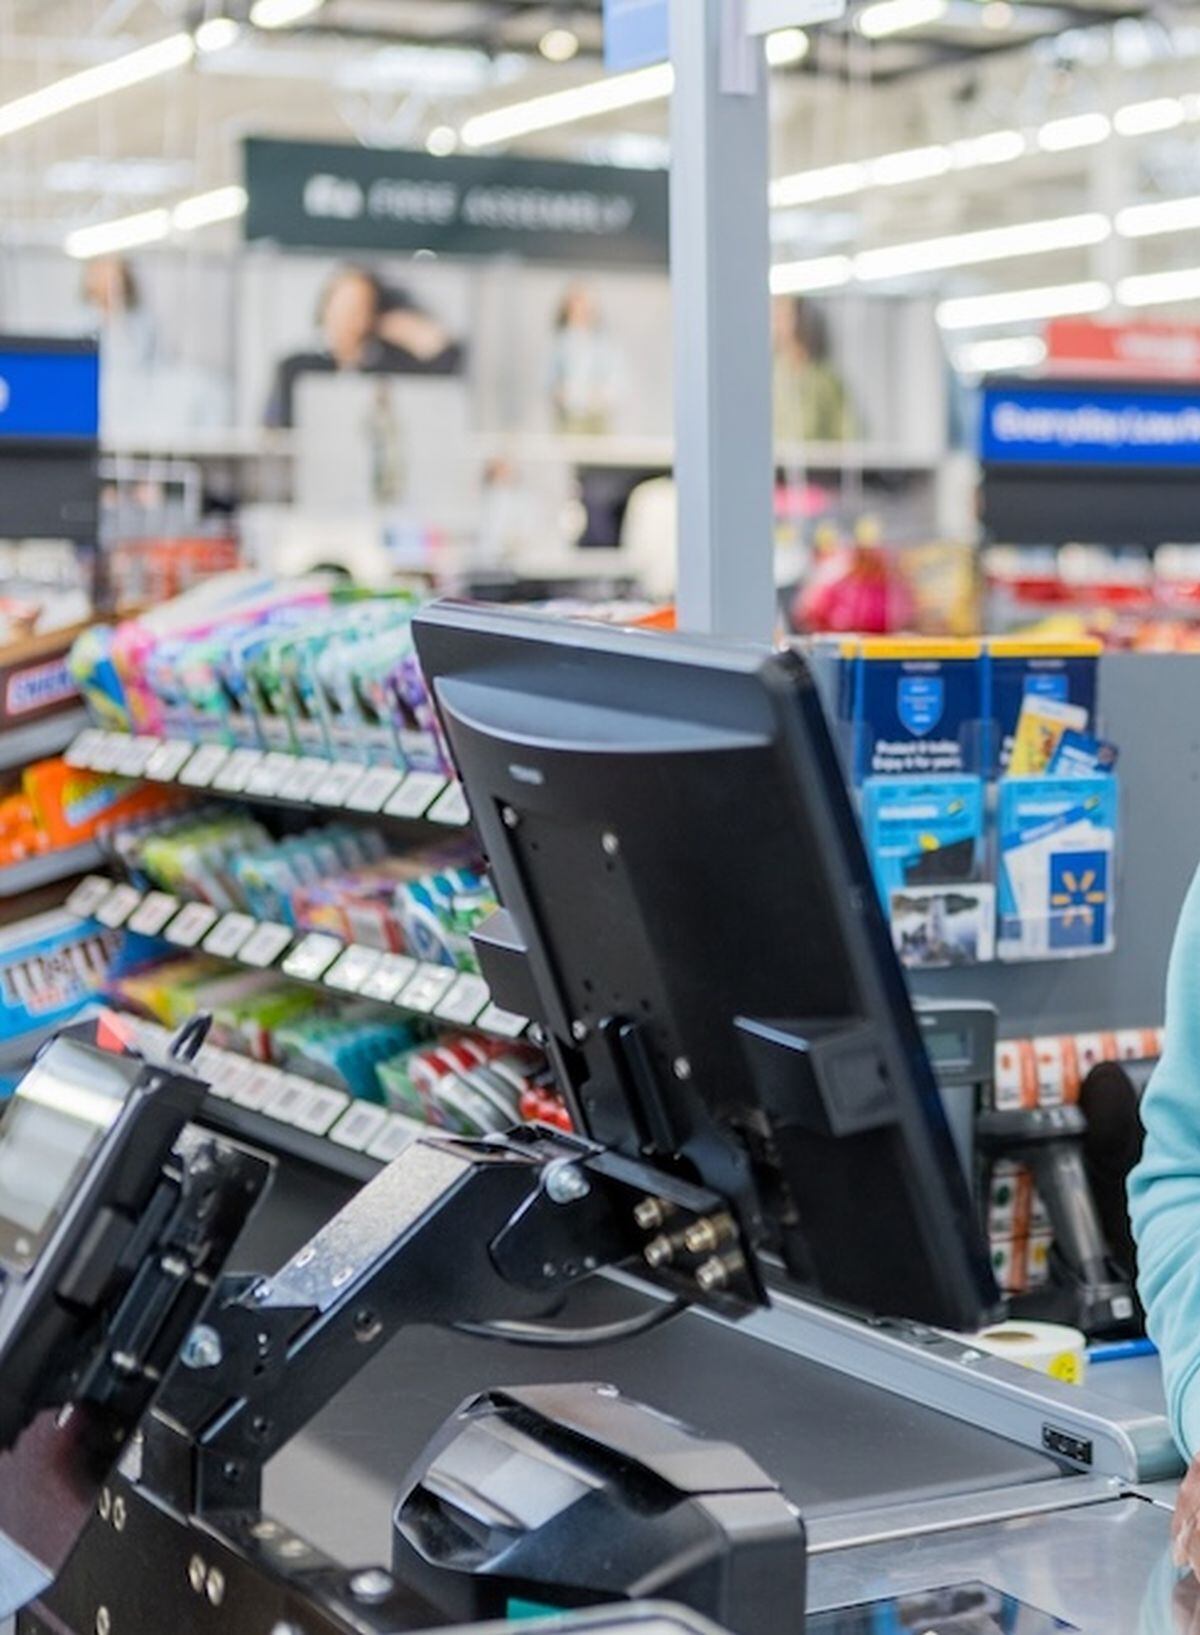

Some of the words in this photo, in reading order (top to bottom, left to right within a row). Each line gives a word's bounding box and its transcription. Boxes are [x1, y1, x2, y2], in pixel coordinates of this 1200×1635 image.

[367, 178, 456, 225] FREE
[461, 183, 634, 235] ASSEMBLY
[992, 401, 1123, 448] Everyday
